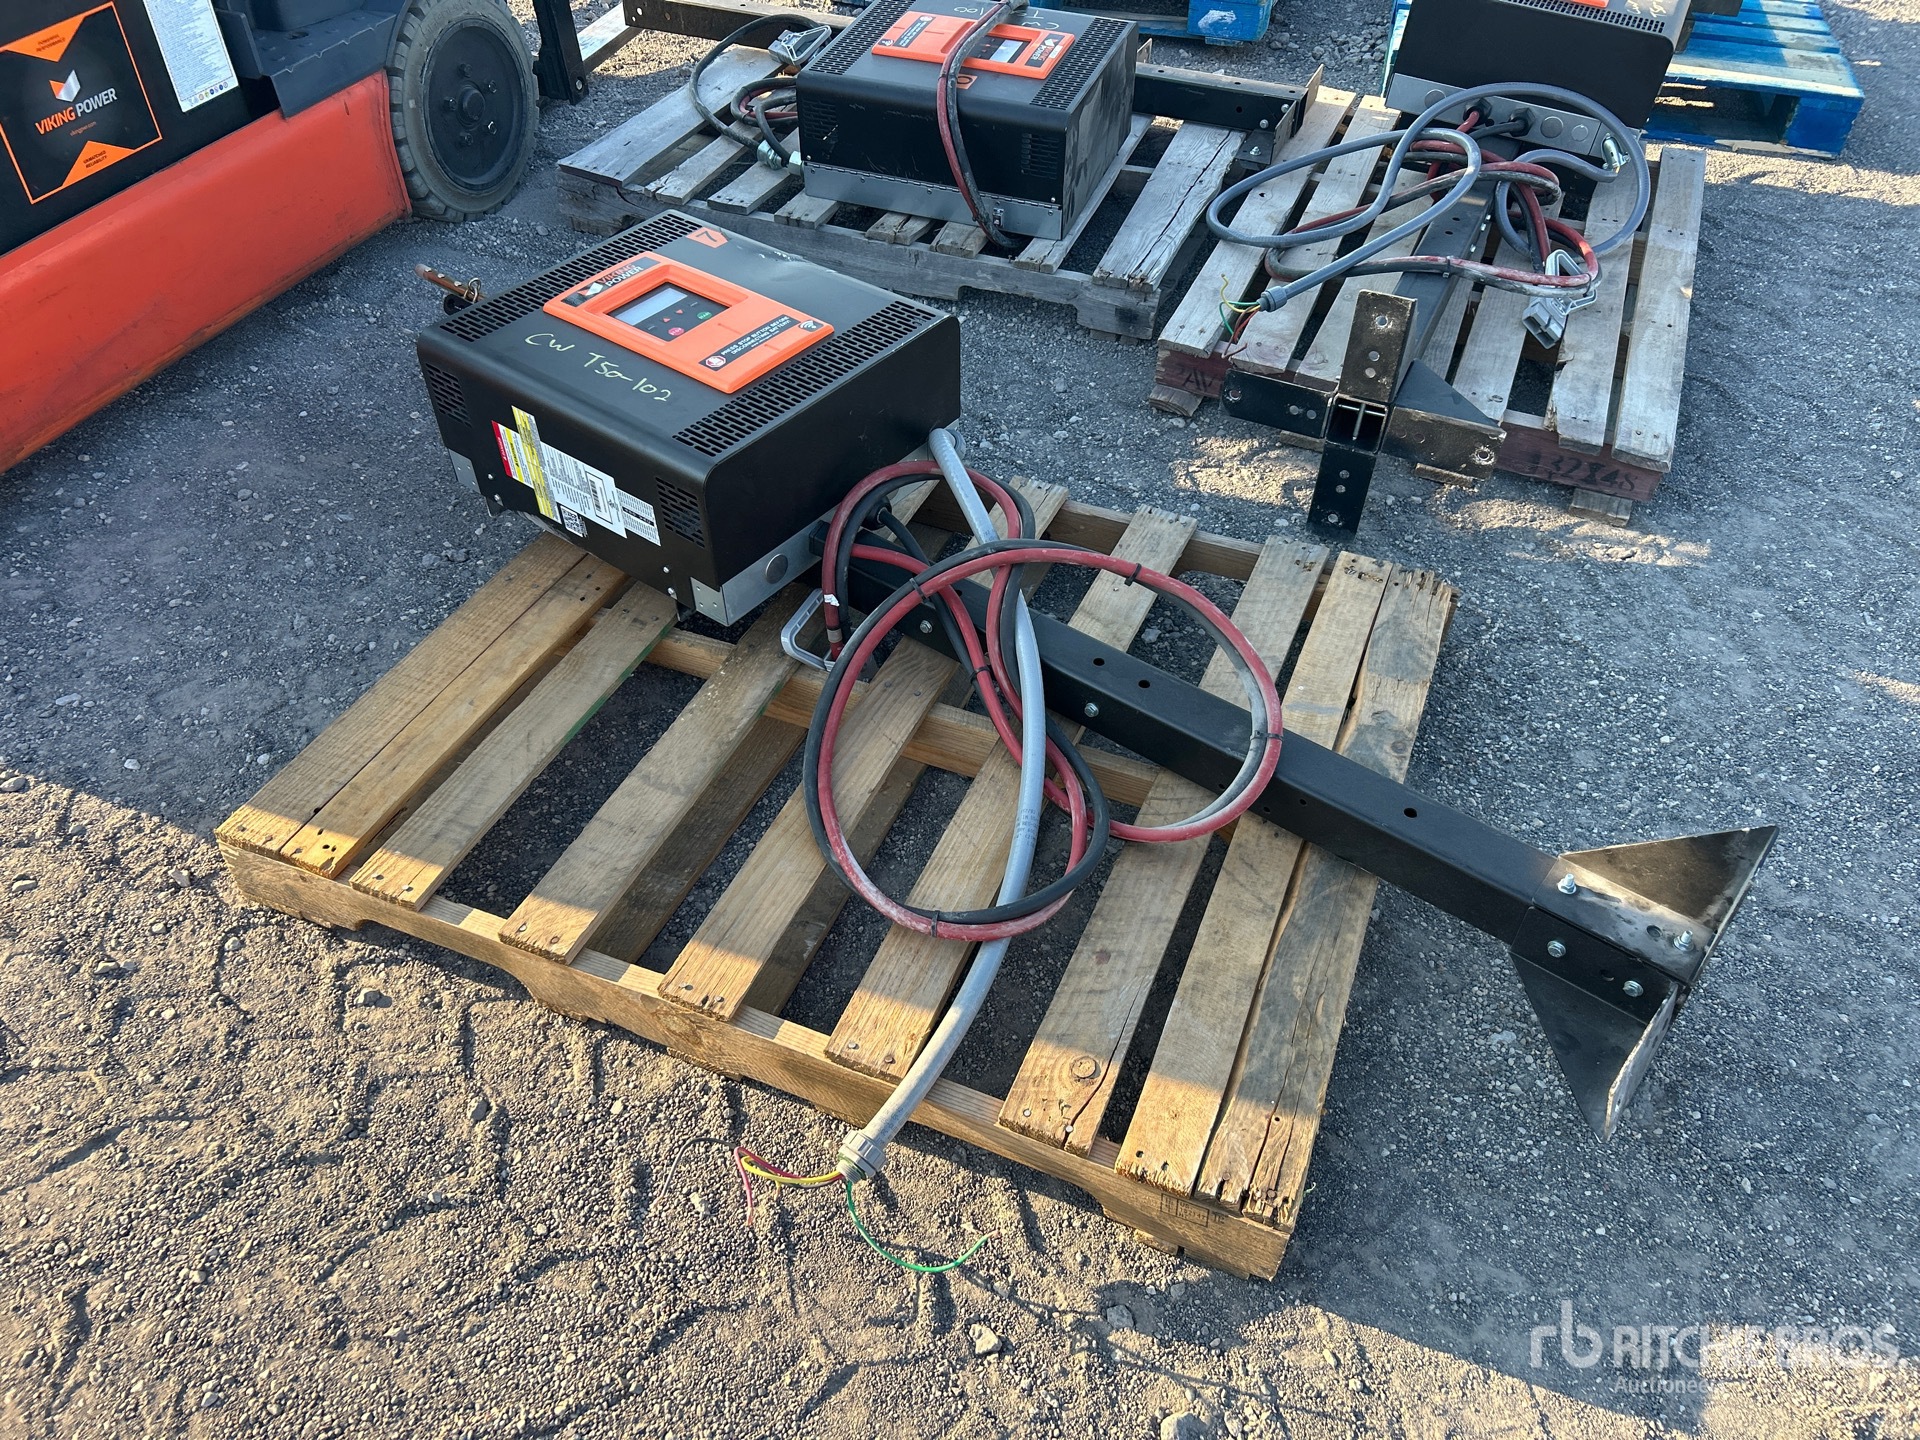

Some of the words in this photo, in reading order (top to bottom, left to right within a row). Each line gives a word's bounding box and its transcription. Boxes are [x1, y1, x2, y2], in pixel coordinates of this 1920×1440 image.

[35, 106, 76, 135] VIKING
[75, 87, 117, 117] POWER
[696, 230, 717, 243] 7
[596, 263, 637, 284] VIKING
[605, 266, 644, 287] POWER
[524, 333, 575, 352] CW
